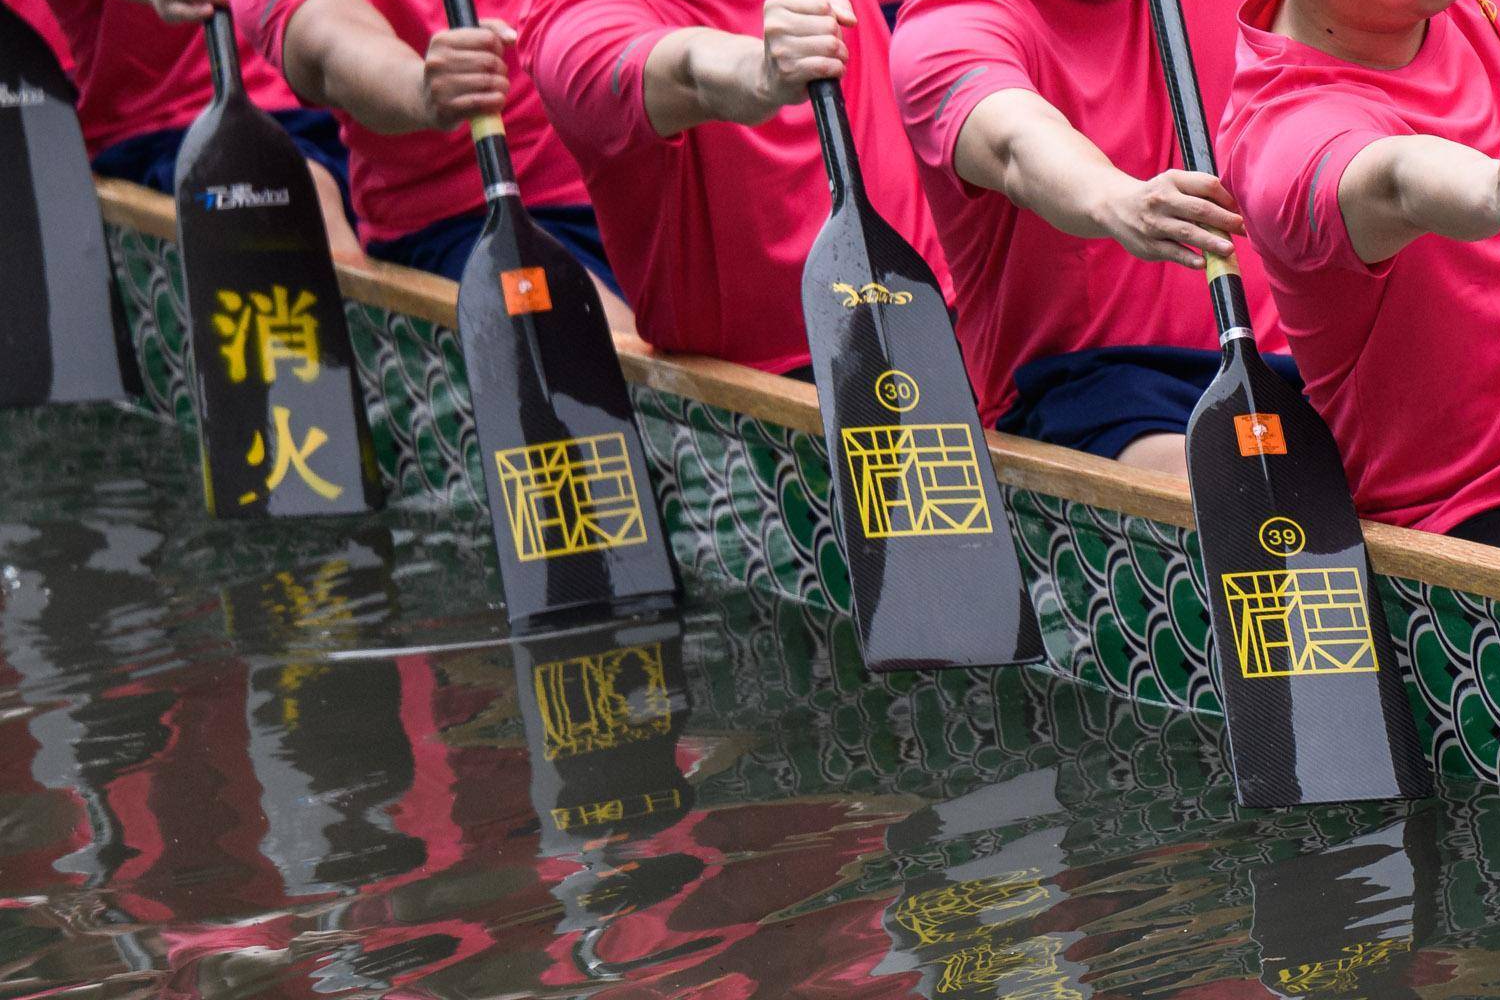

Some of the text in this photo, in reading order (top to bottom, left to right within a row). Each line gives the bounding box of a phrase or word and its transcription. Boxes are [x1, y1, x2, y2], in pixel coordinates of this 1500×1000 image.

[213, 285, 344, 505] 消火
[884, 383, 911, 400] 30
[1268, 529, 1297, 546] 39
